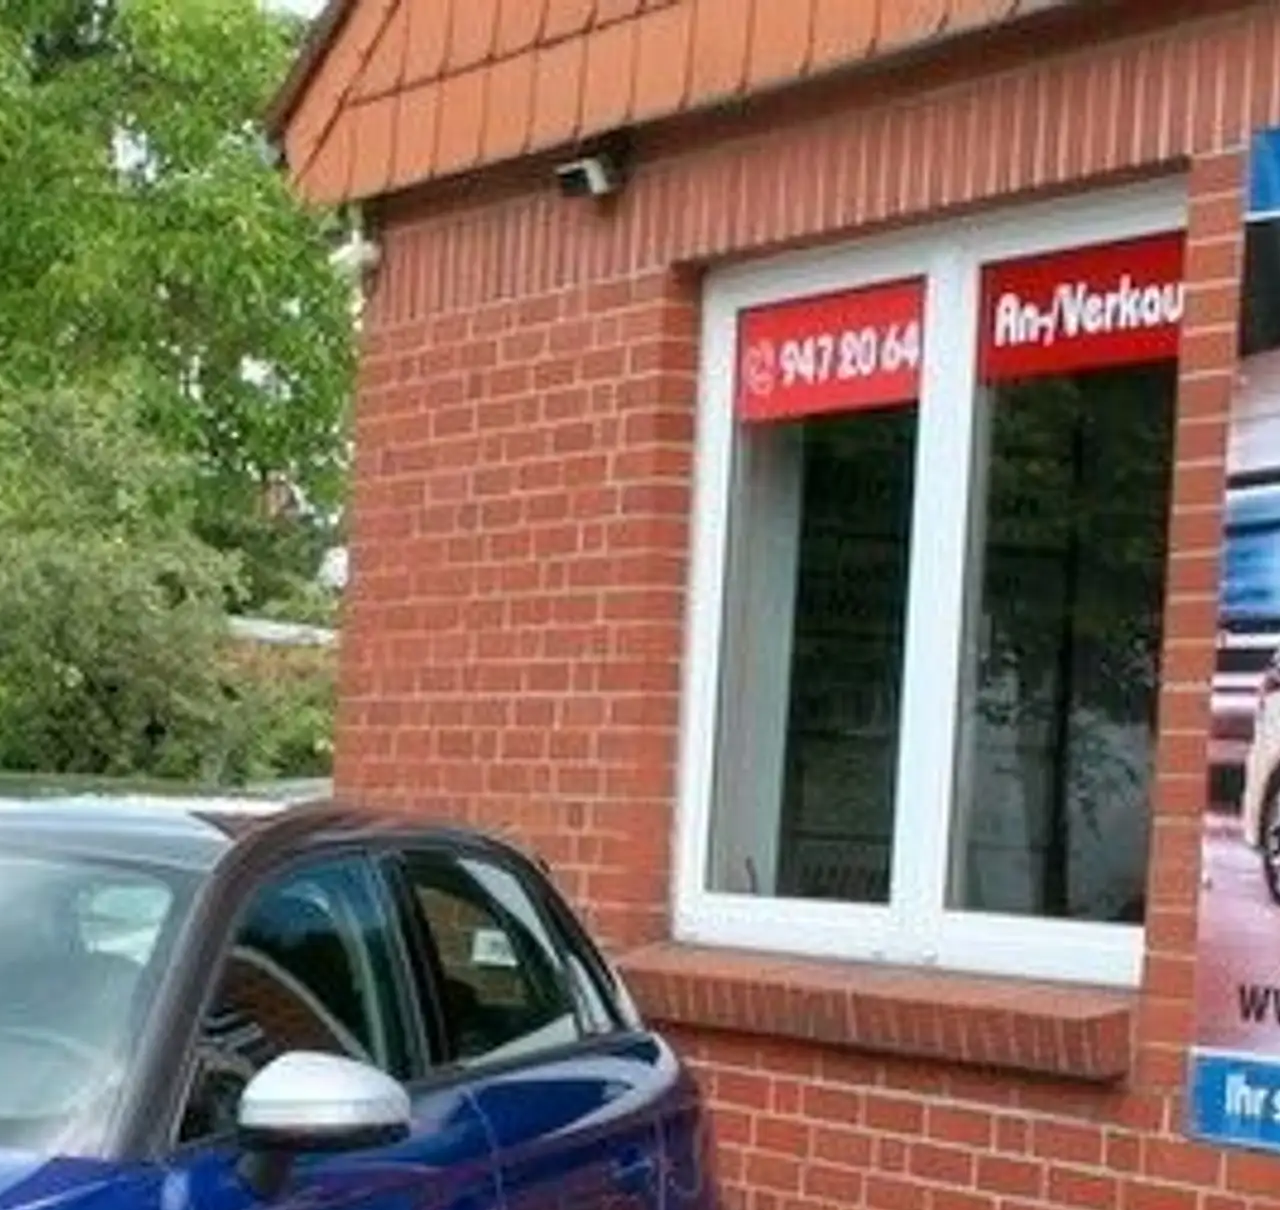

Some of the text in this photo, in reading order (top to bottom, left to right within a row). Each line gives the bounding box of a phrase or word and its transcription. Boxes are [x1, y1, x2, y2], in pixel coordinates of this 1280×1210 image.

[779, 318, 920, 388] 947 20 64
[1225, 1071, 1269, 1118] Ihr
